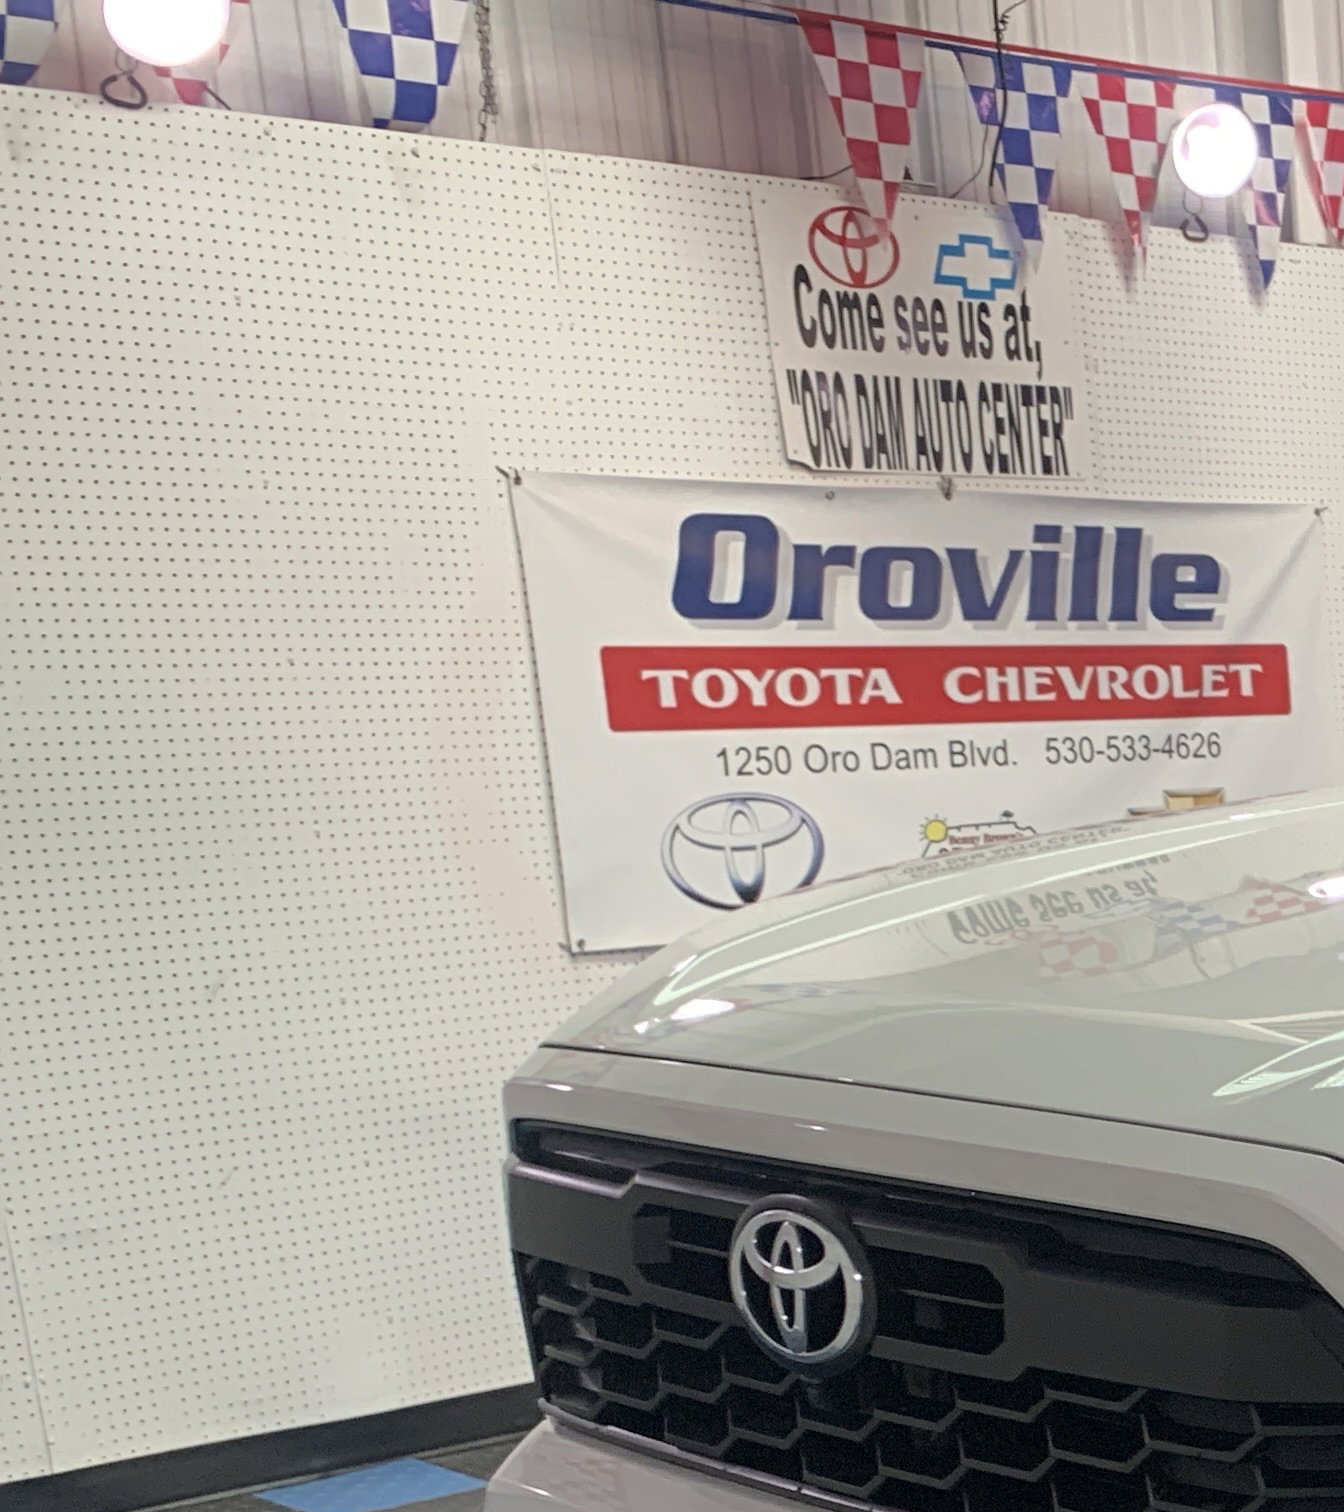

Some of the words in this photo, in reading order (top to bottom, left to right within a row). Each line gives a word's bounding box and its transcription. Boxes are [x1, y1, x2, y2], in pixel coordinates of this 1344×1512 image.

[794, 264, 885, 352] Come
[894, 294, 948, 356] see
[958, 300, 993, 359] us
[1004, 289, 1043, 380] at,
[786, 369, 852, 468] "ORO
[854, 374, 909, 469] DAM
[913, 377, 973, 473] AUTO
[979, 380, 1074, 475] CENTER"
[671, 512, 1222, 624] Oroville
[641, 667, 902, 709] TOYOTA
[944, 662, 1264, 705] CHEVROLET
[717, 747, 792, 777] 1250
[803, 744, 861, 774] Oro
[872, 742, 938, 771] Dam
[951, 737, 1018, 769] Blvd.
[1045, 732, 1222, 766] 530-533-4626
